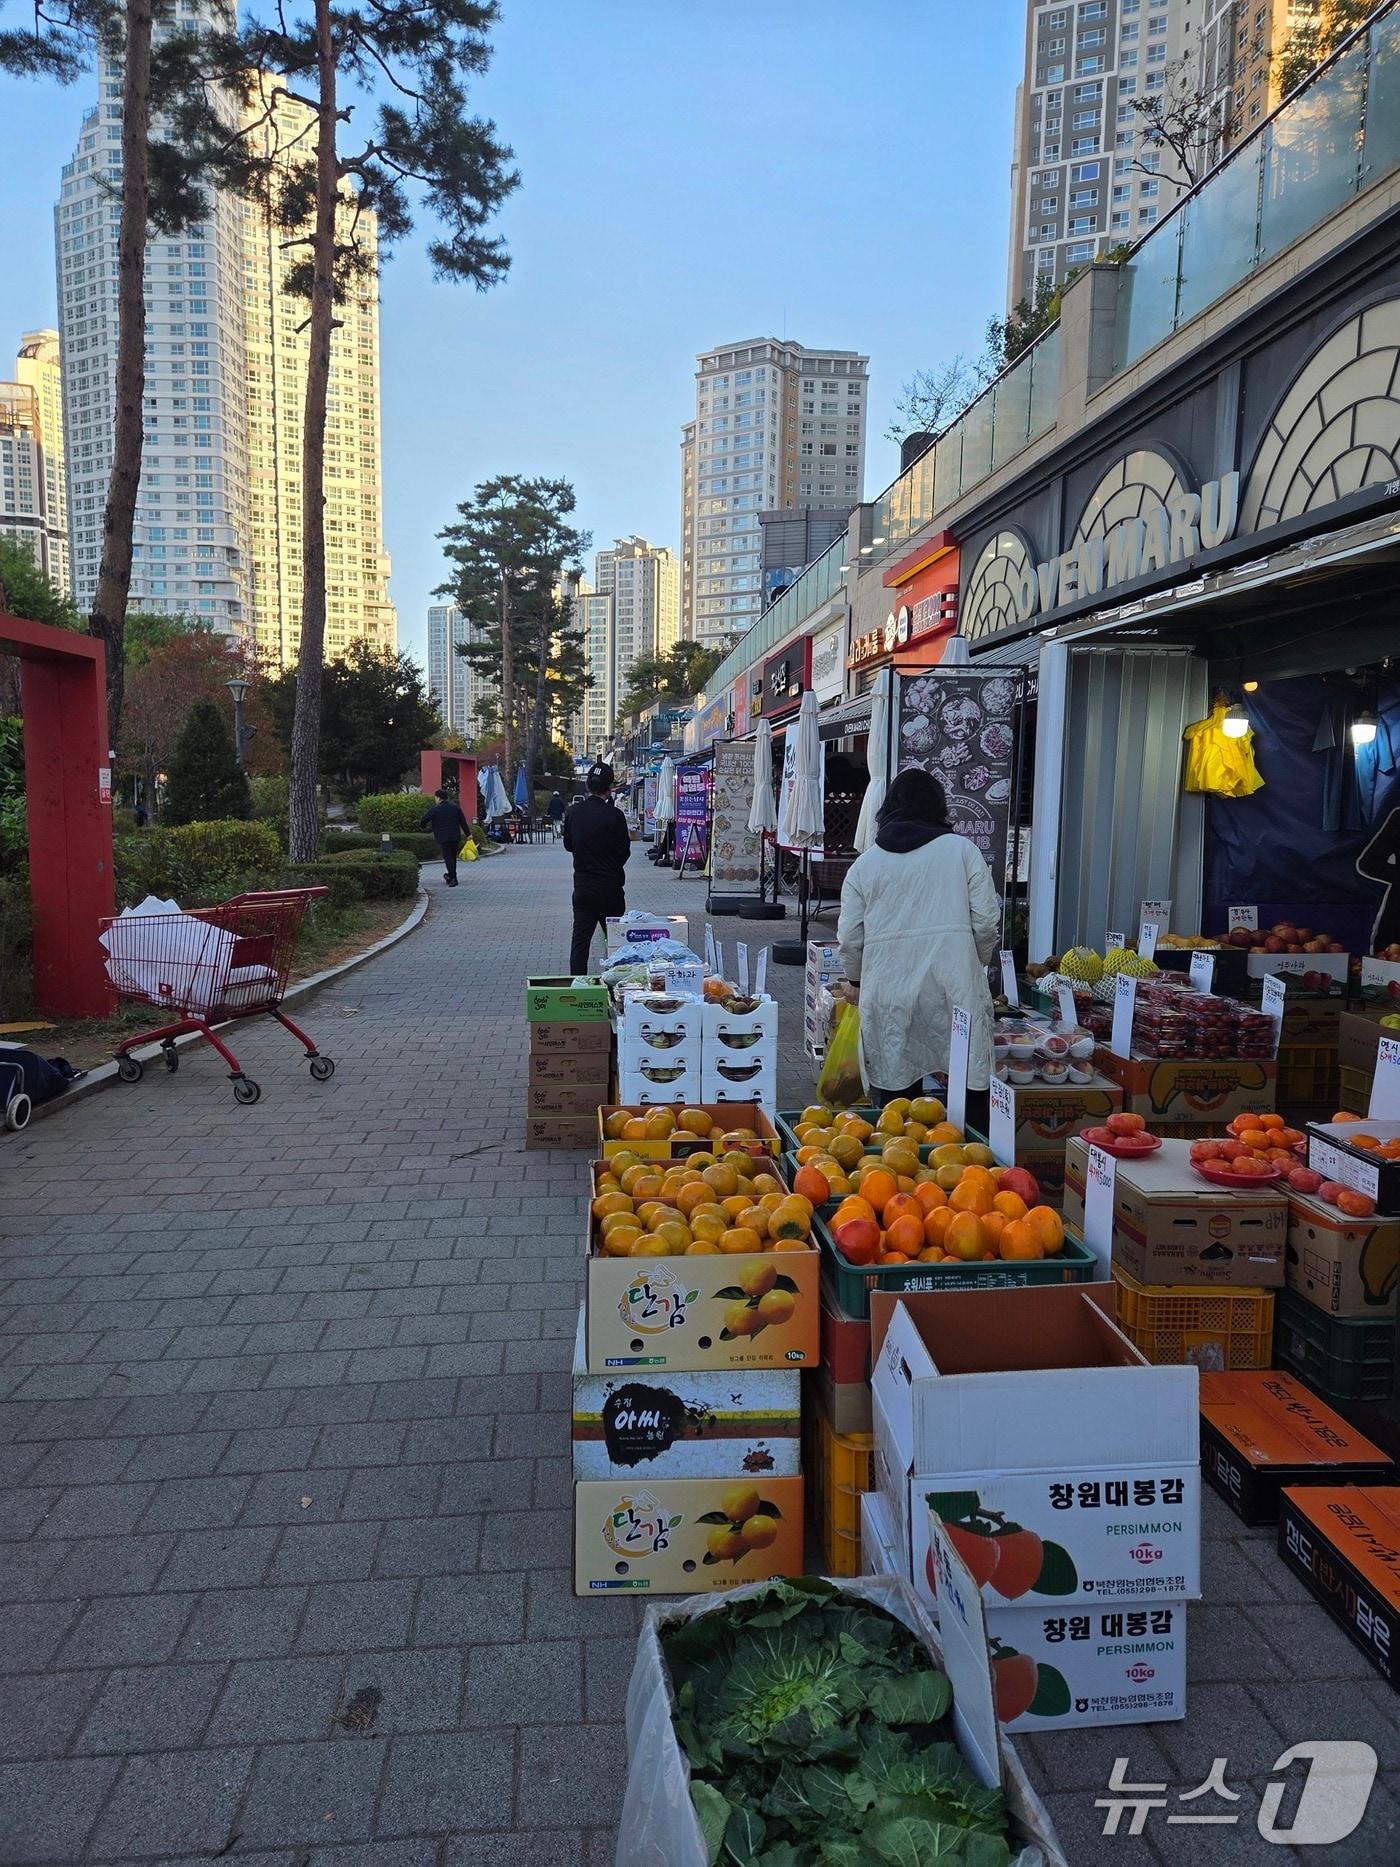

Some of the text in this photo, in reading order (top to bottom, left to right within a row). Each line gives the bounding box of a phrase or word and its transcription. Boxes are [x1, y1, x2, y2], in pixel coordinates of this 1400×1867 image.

[786, 1350, 805, 1360] 10kg
[1106, 1521, 1182, 1537] PERSIMMON
[1129, 1547, 1163, 1561] 10kg
[1043, 1610, 1173, 1643] 창원 대봉감
[1097, 1641, 1174, 1656] PERSIMMON
[1125, 1666, 1155, 1679] 10kg
